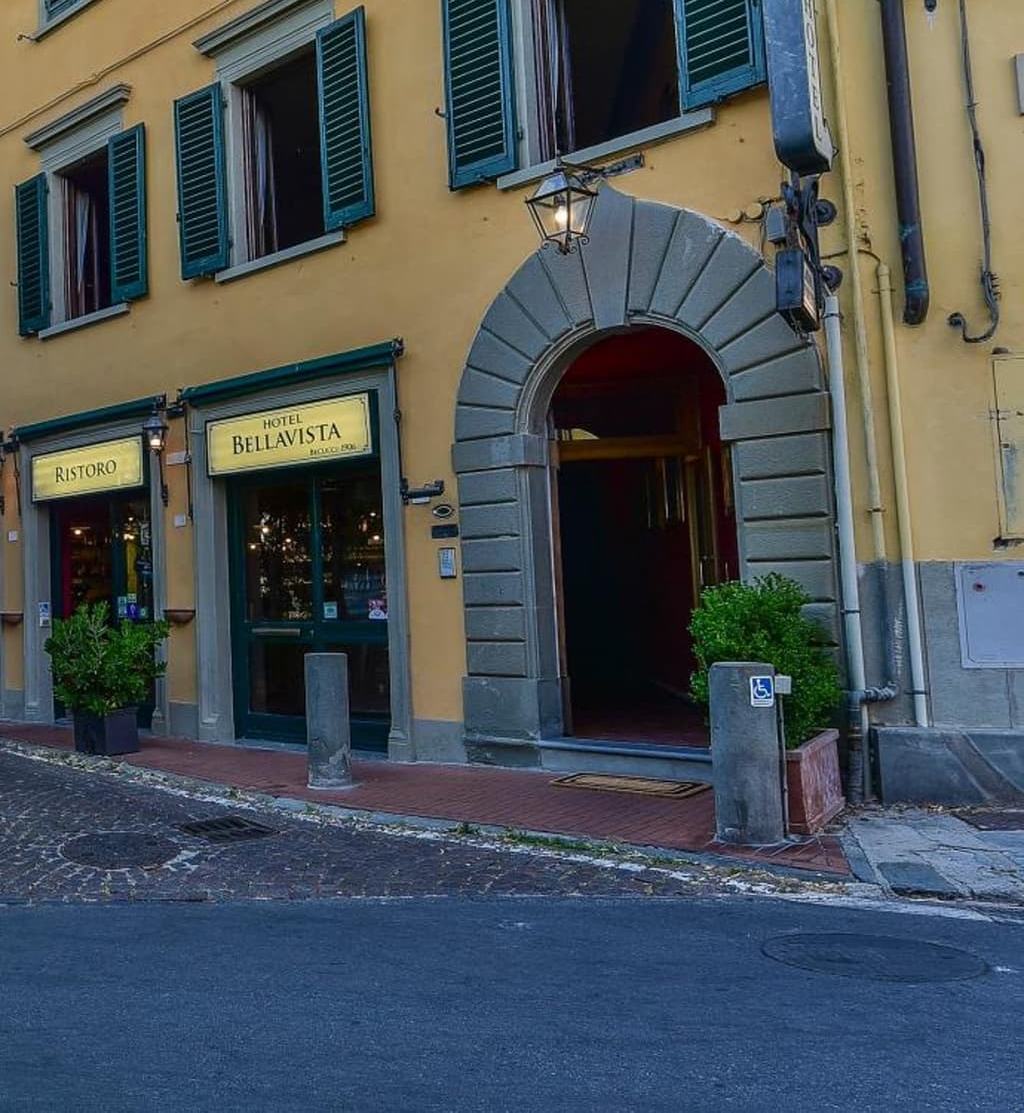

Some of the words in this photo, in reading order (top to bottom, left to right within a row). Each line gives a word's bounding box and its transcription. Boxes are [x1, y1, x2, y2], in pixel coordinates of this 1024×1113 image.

[263, 413, 304, 430] HOTEL
[232, 422, 342, 455] BELLAVISTA
[55, 459, 117, 483] RISTORO
